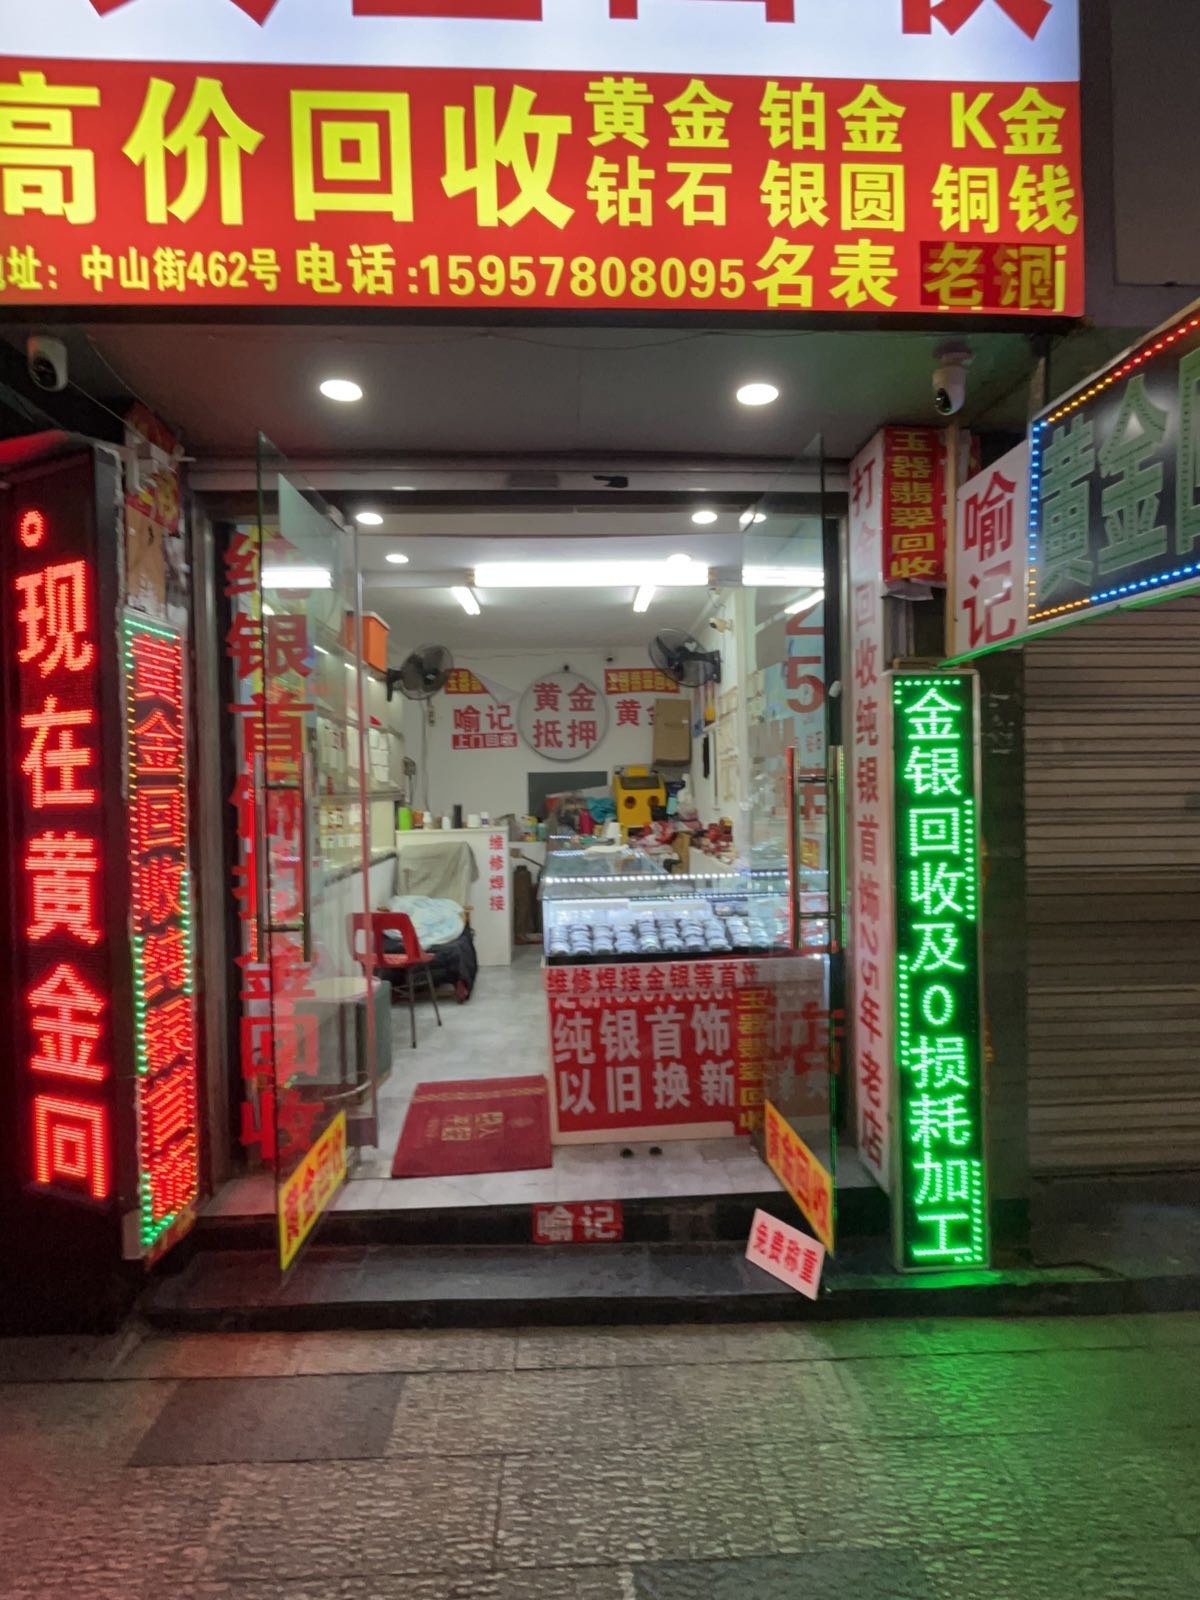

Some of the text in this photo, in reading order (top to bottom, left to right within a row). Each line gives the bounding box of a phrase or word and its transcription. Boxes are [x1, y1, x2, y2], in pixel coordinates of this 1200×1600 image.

[585, 77, 1066, 156] 黄金 铂金 K金
[0, 72, 574, 229] 高价回收
[586, 157, 1078, 235] 钻石 银圆 铜钱
[752, 238, 899, 308] 名表
[890, 431, 936, 578] 玉器翡翠回收
[963, 471, 1016, 648] 喻记
[453, 704, 514, 732] 喻记
[533, 683, 597, 712] 黄金
[533, 719, 598, 748] 抵押
[554, 1003, 732, 1064] 纯银首饰
[559, 1060, 735, 1115] 以旧换新
[536, 1206, 618, 1242] 喻记
